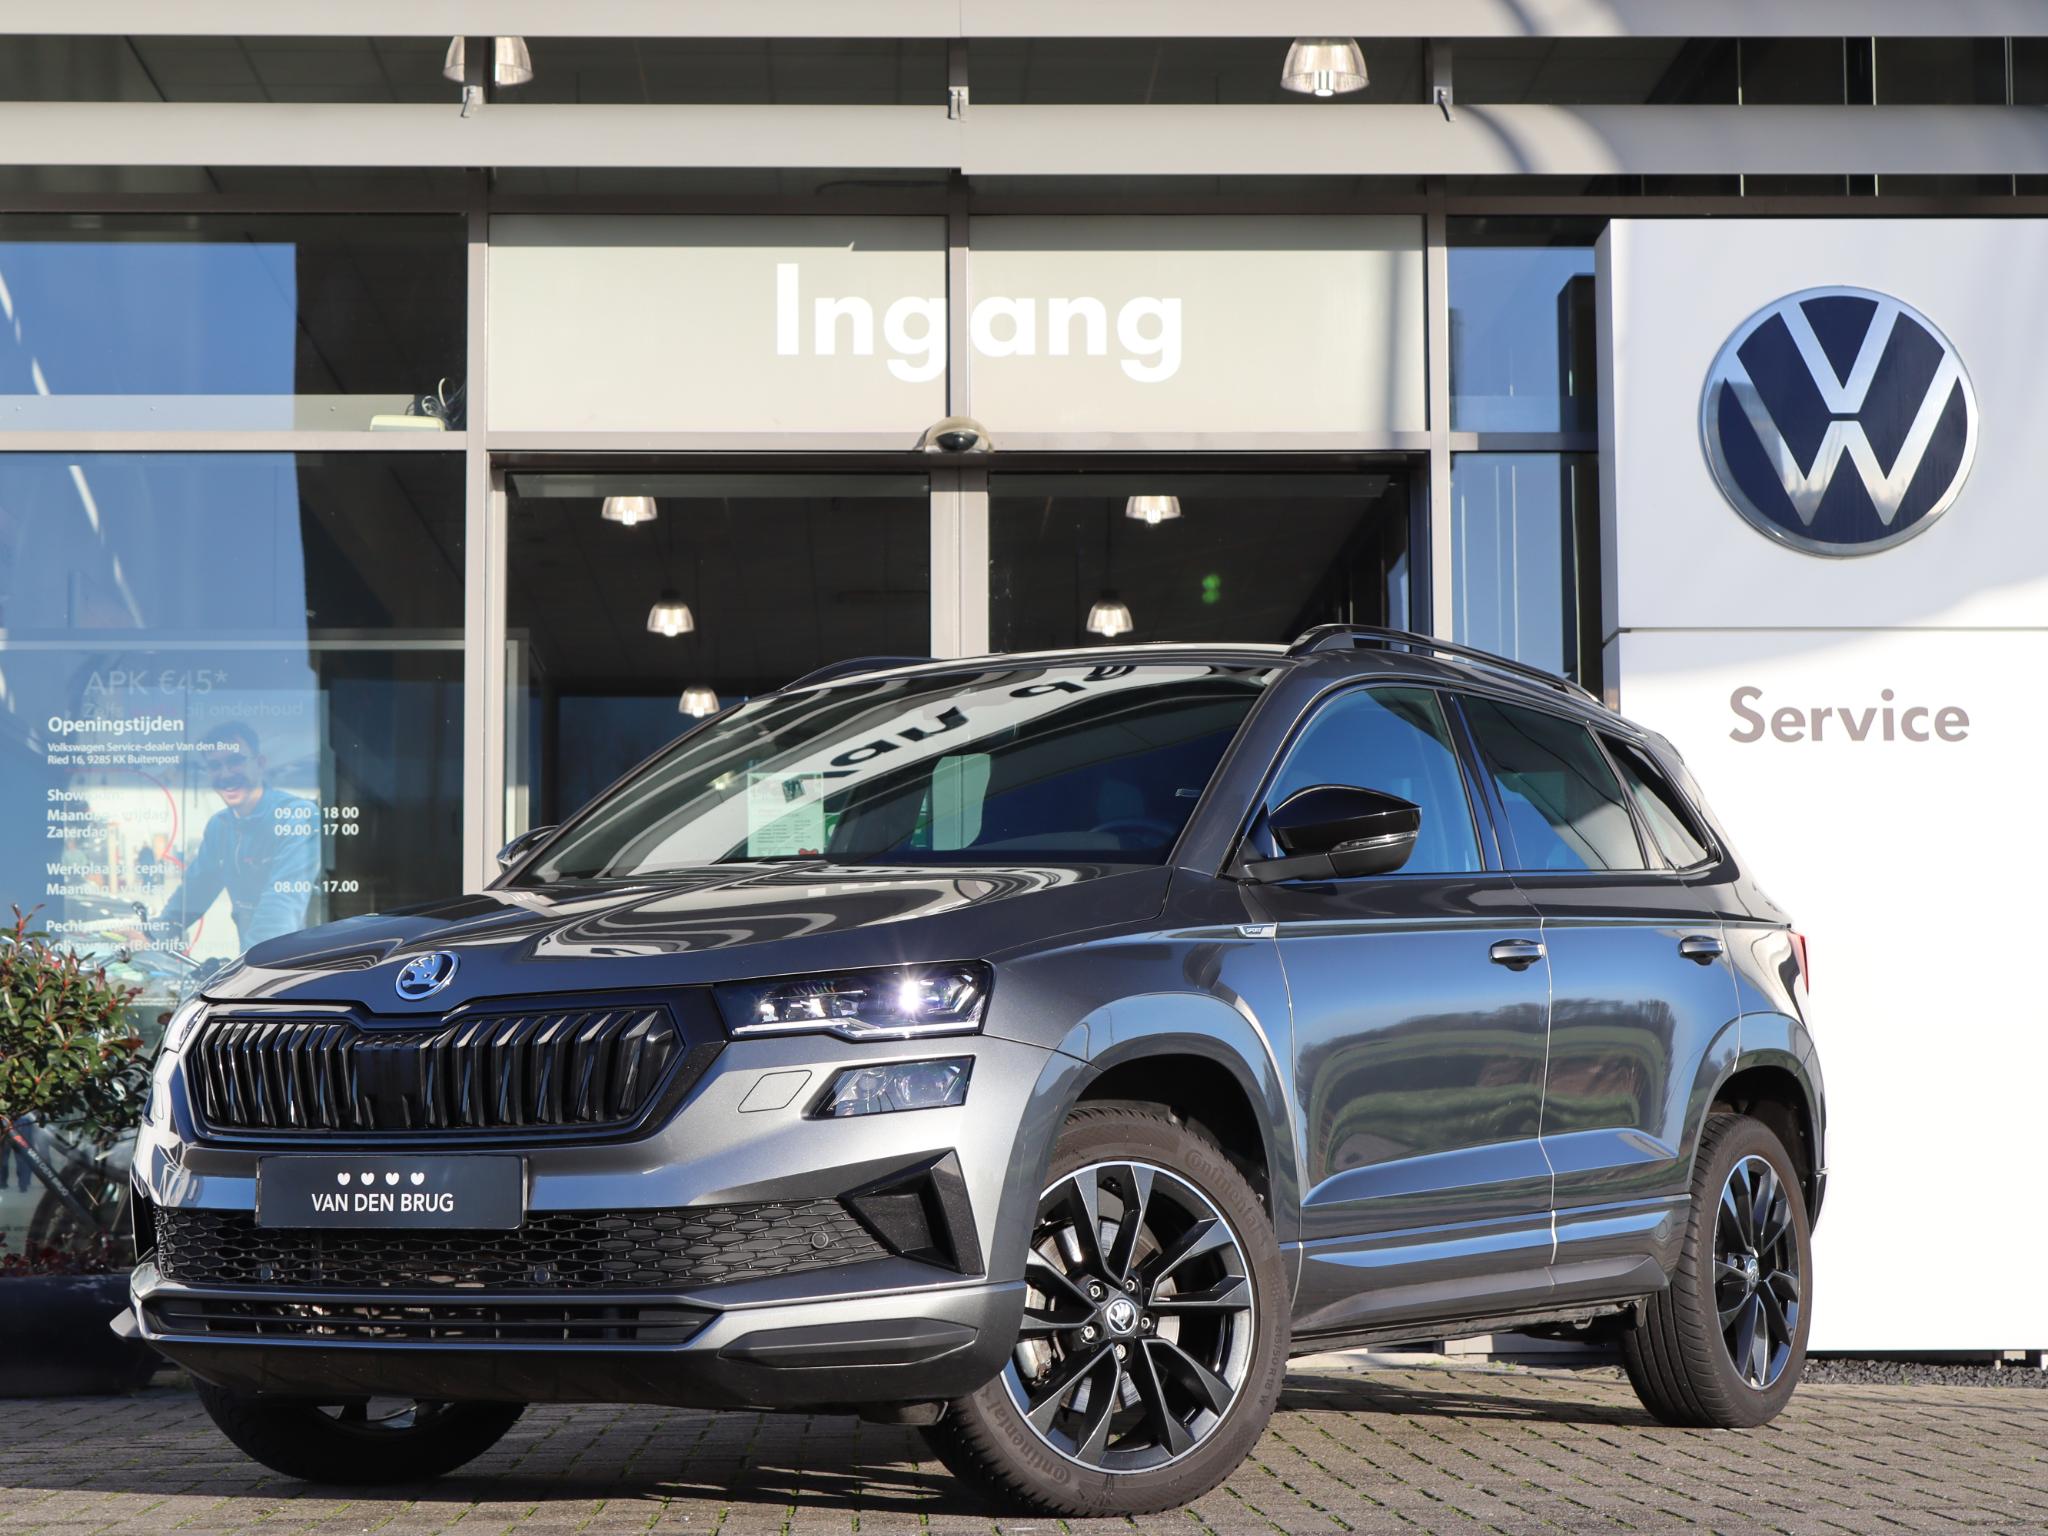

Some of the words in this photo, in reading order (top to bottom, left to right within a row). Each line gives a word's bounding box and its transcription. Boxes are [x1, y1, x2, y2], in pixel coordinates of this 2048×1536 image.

[776, 262, 1183, 383] Ingang
[84, 671, 148, 695] APK
[209, 701, 304, 716] onderhoud
[1729, 686, 1970, 743] Service
[48, 716, 184, 735] Openingstijden
[48, 743, 105, 753] Volkswagen
[107, 743, 175, 752] Service-dealer
[176, 742, 193, 751] Van
[196, 742, 214, 751] den
[217, 741, 240, 752] Brug
[48, 755, 69, 764] Ried
[72, 755, 85, 765] 16,
[87, 755, 111, 764] 9285
[113, 755, 126, 764] KK
[128, 755, 179, 765] Buitenpost
[274, 807, 311, 819] 09.00
[274, 824, 311, 836] 09.00
[47, 862, 180, 876] Werkplaasrceptie:
[274, 881, 311, 892] 08.00
[323, 881, 359, 892] 17.00
[312, 1194, 348, 1211] VAN
[355, 1194, 394, 1212] DEN
[400, 1193, 453, 1212] BRUG
